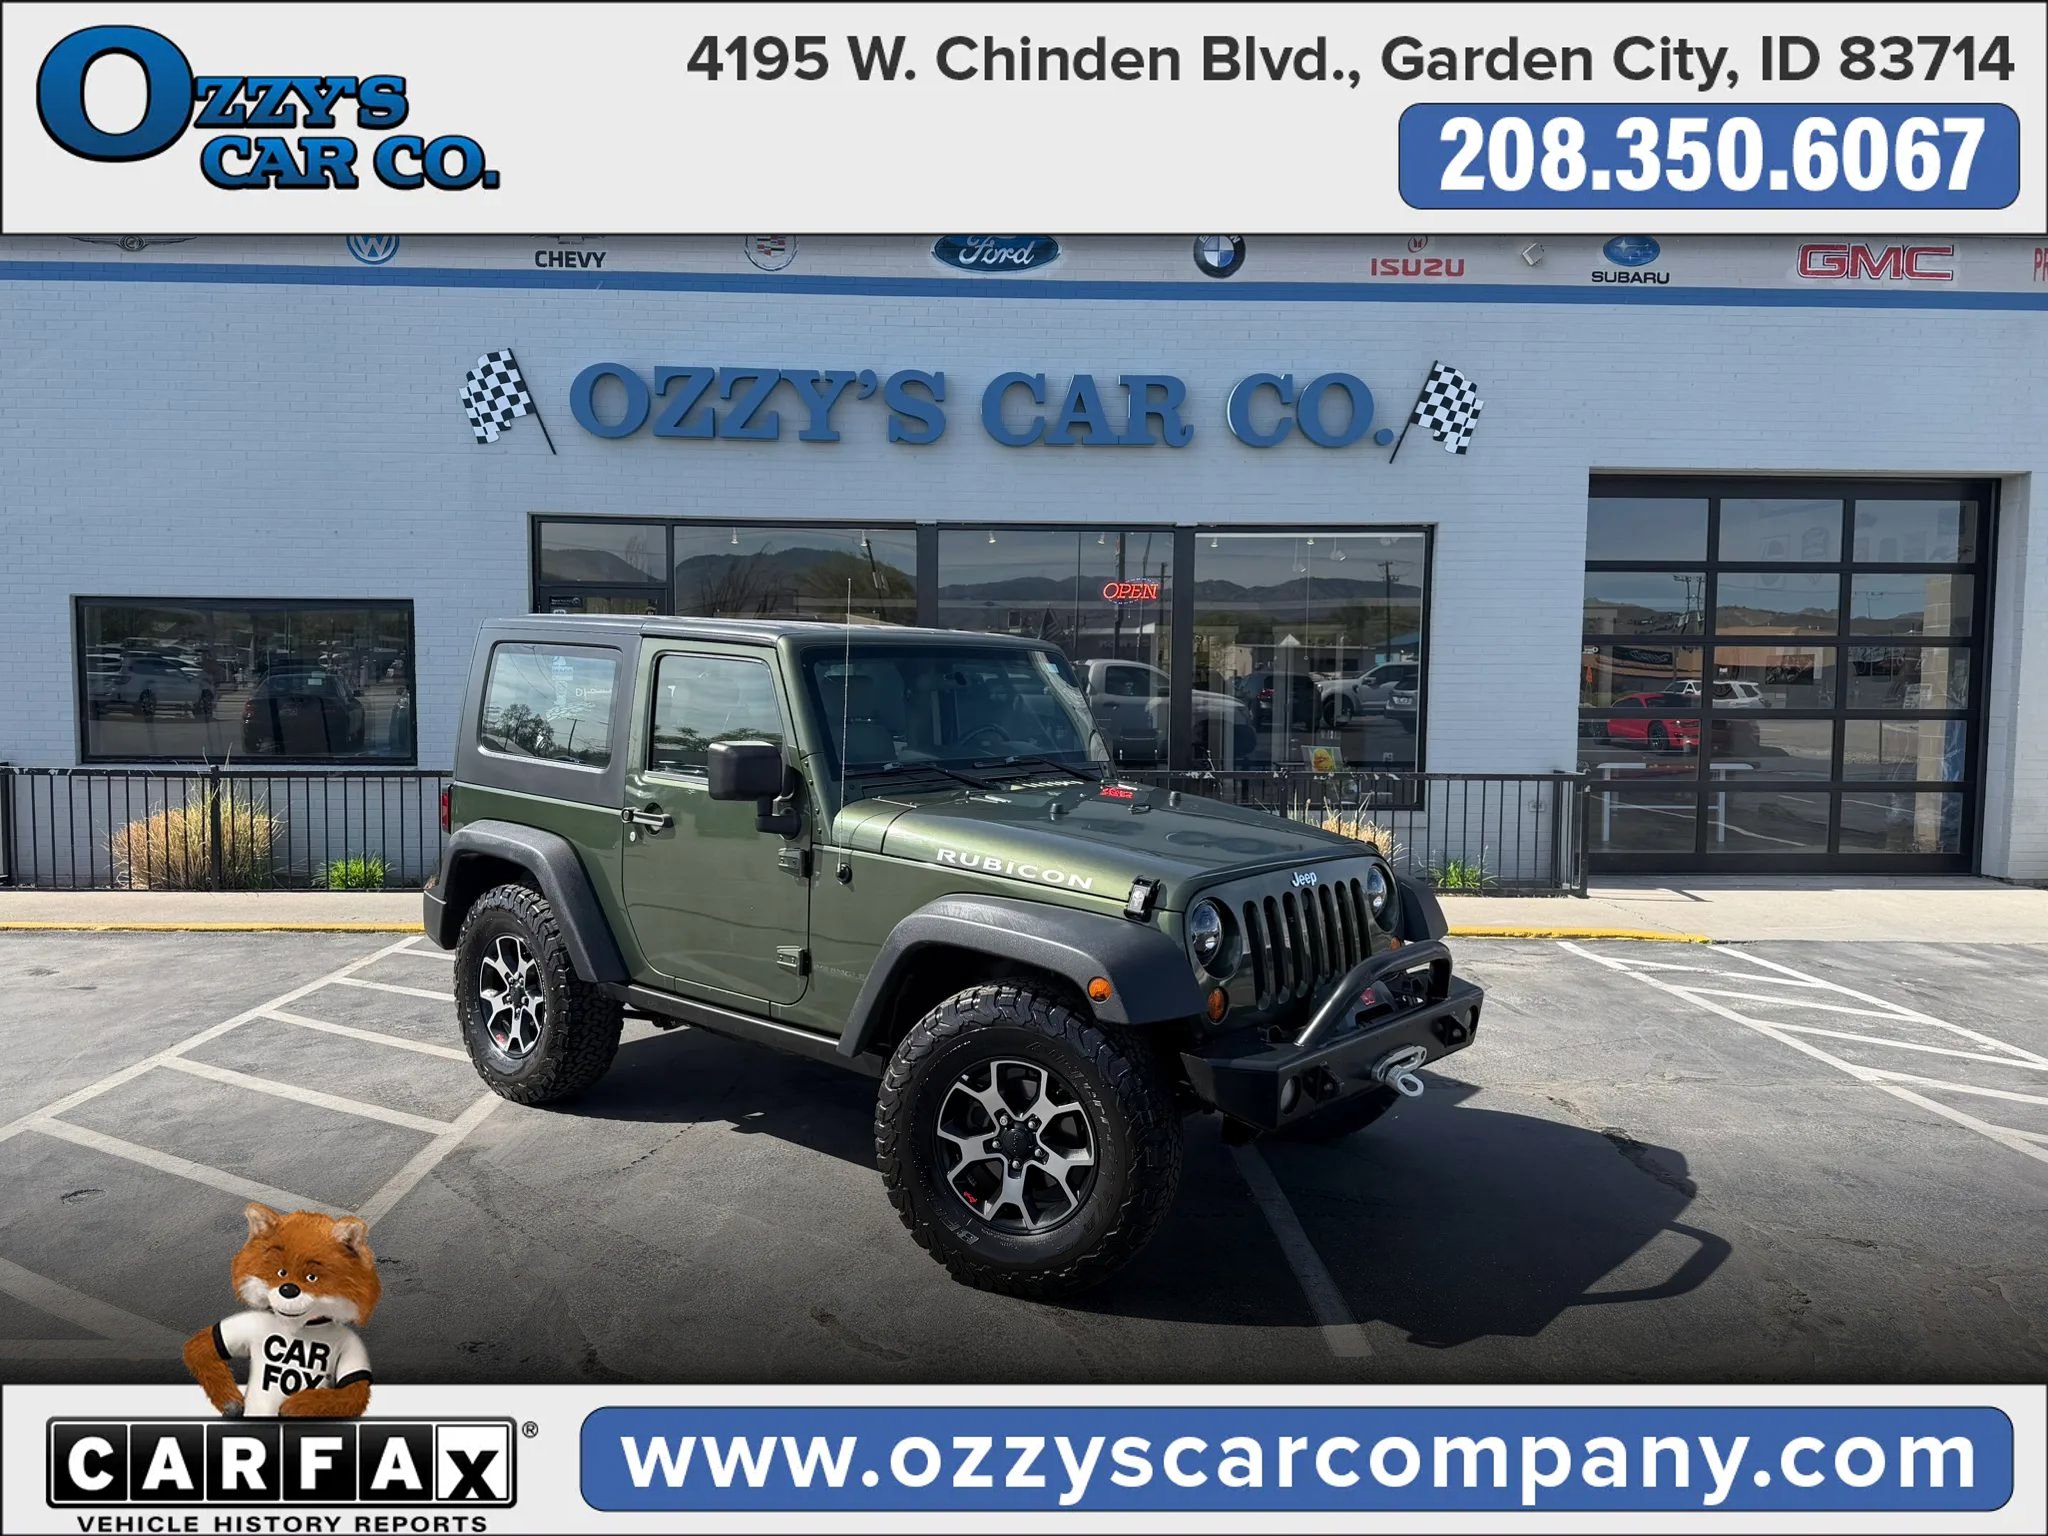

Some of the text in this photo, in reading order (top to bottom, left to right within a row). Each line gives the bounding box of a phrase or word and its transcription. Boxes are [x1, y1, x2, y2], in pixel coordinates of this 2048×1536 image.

[535, 250, 606, 268] CHEVY
[958, 235, 1035, 265] Ford
[1371, 258, 1464, 277] ISUZU
[1797, 242, 1954, 281] GMC
[1591, 271, 1670, 284] SUBARU
[569, 362, 1395, 448] OZZY'S CAR CO.
[1103, 582, 1159, 600] OPEN
[936, 848, 1094, 890] RUBICON
[1291, 871, 1317, 887] Jeep
